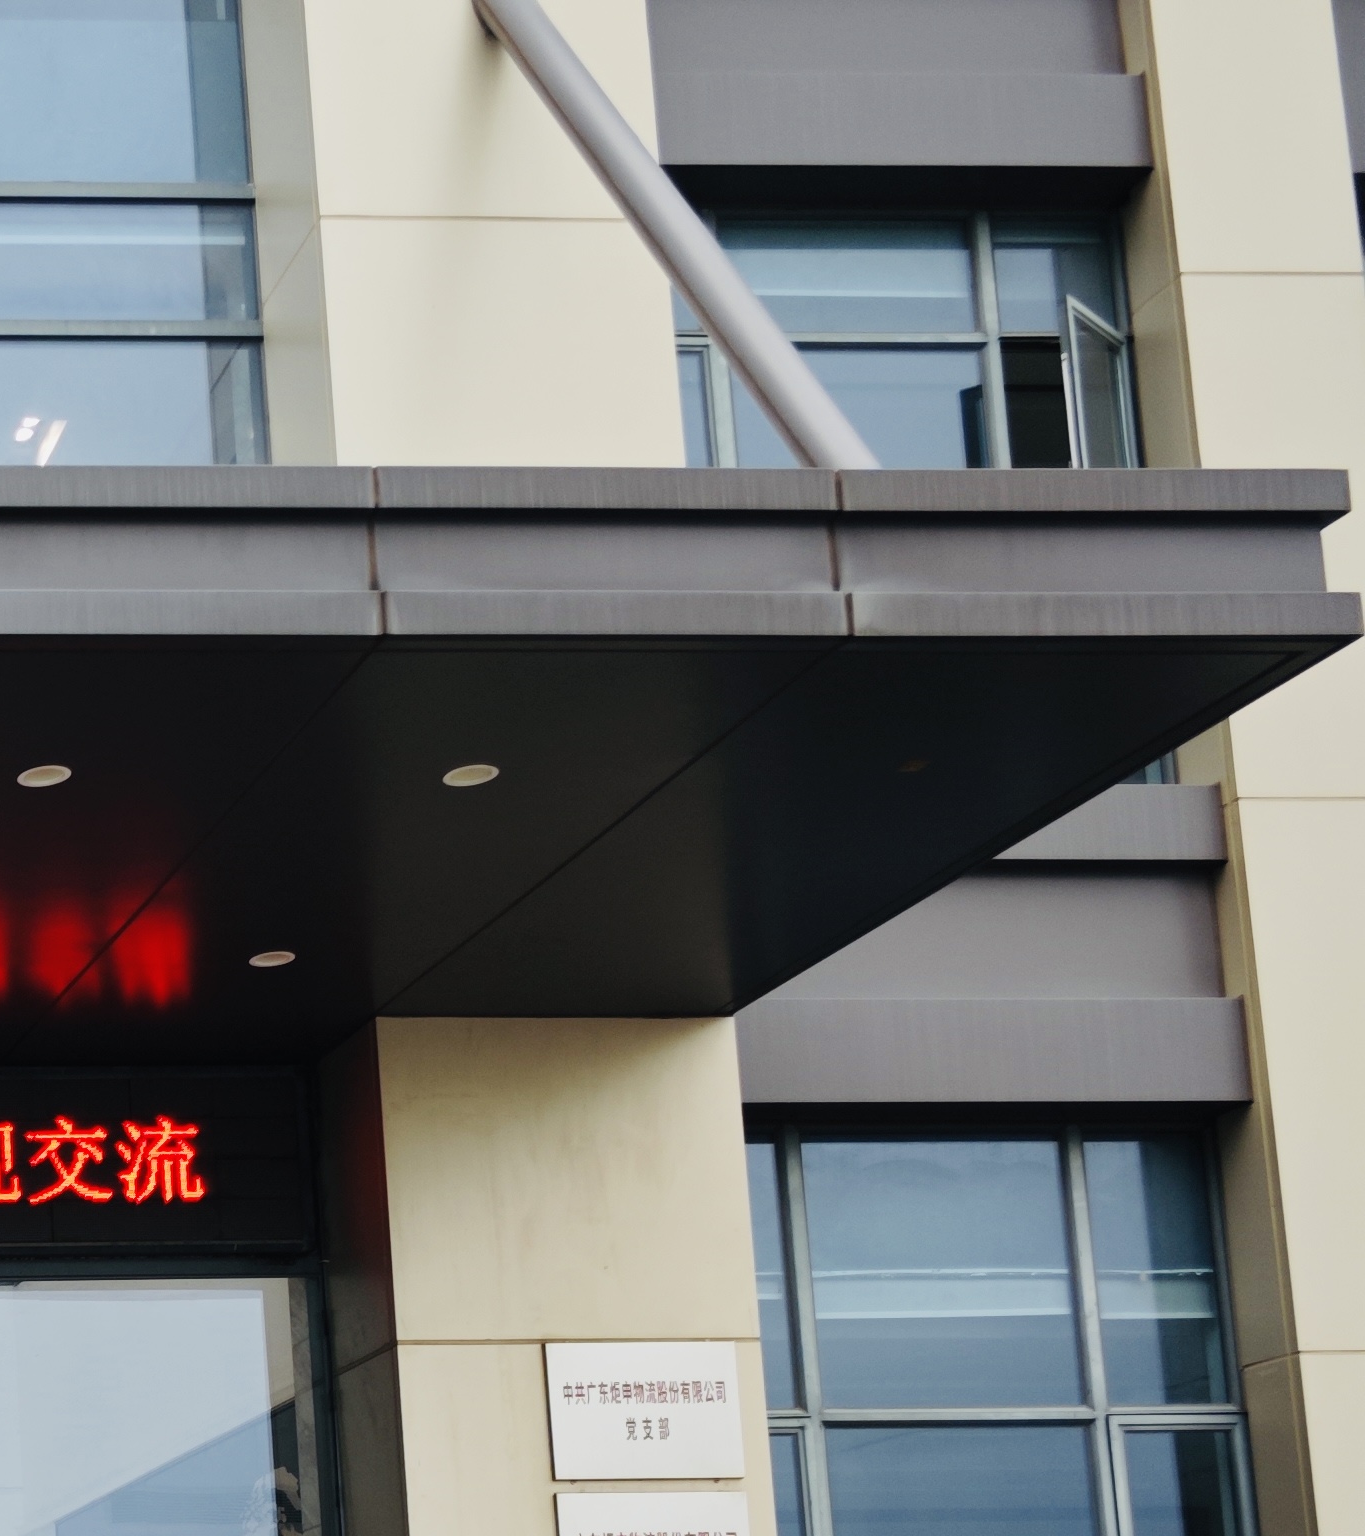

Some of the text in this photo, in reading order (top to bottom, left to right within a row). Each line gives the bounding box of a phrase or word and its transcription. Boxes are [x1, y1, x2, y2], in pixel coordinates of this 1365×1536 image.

[562, 1380, 727, 1405] 中共广东炬申物流股份有限公司
[625, 1417, 670, 1441] 党支部
